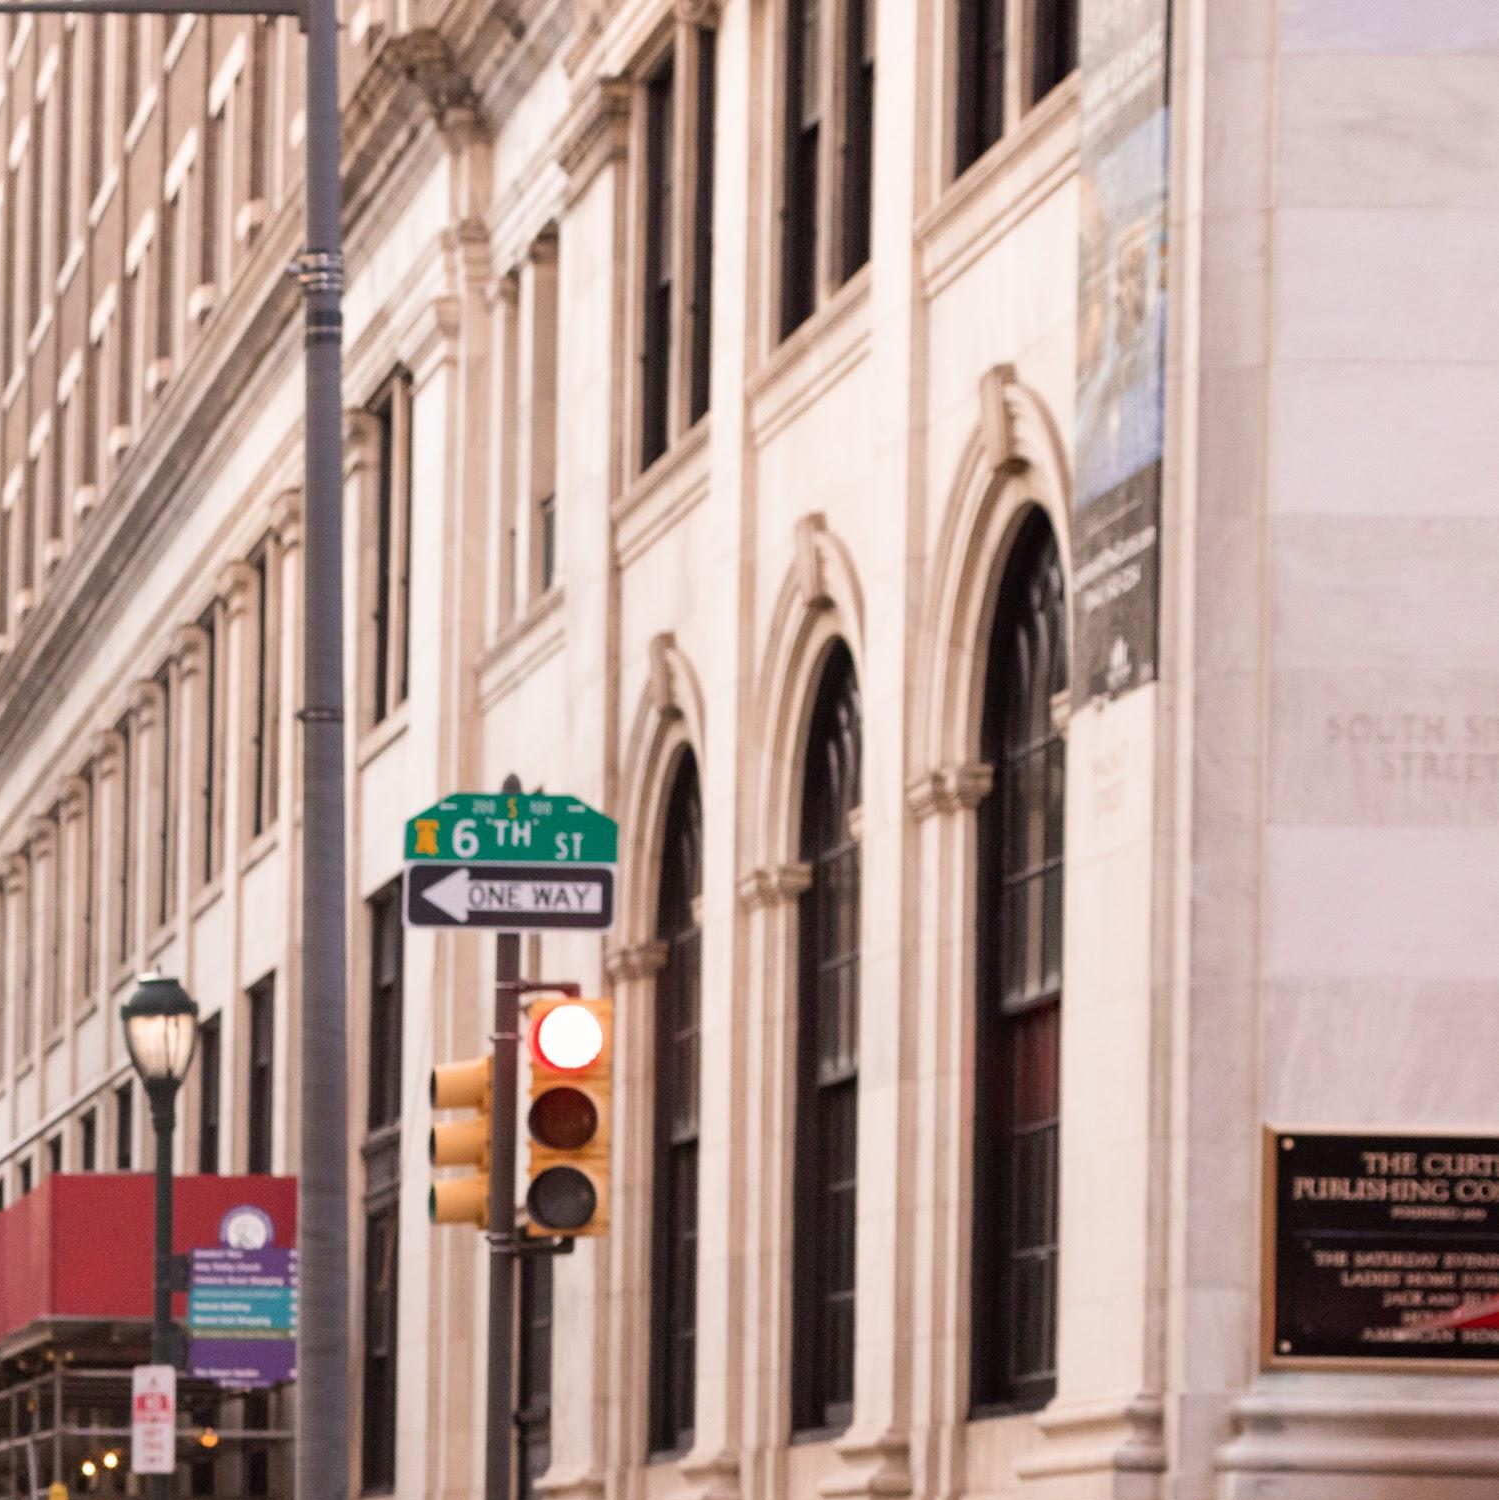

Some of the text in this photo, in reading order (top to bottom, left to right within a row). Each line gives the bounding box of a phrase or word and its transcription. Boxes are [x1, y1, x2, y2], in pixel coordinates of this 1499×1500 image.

[507, 797, 518, 818] S
[554, 832, 584, 860] ST
[469, 882, 591, 910] ONE WAY
[1361, 1151, 1418, 1175] THE
[1293, 1176, 1450, 1201] PUBLISHING
